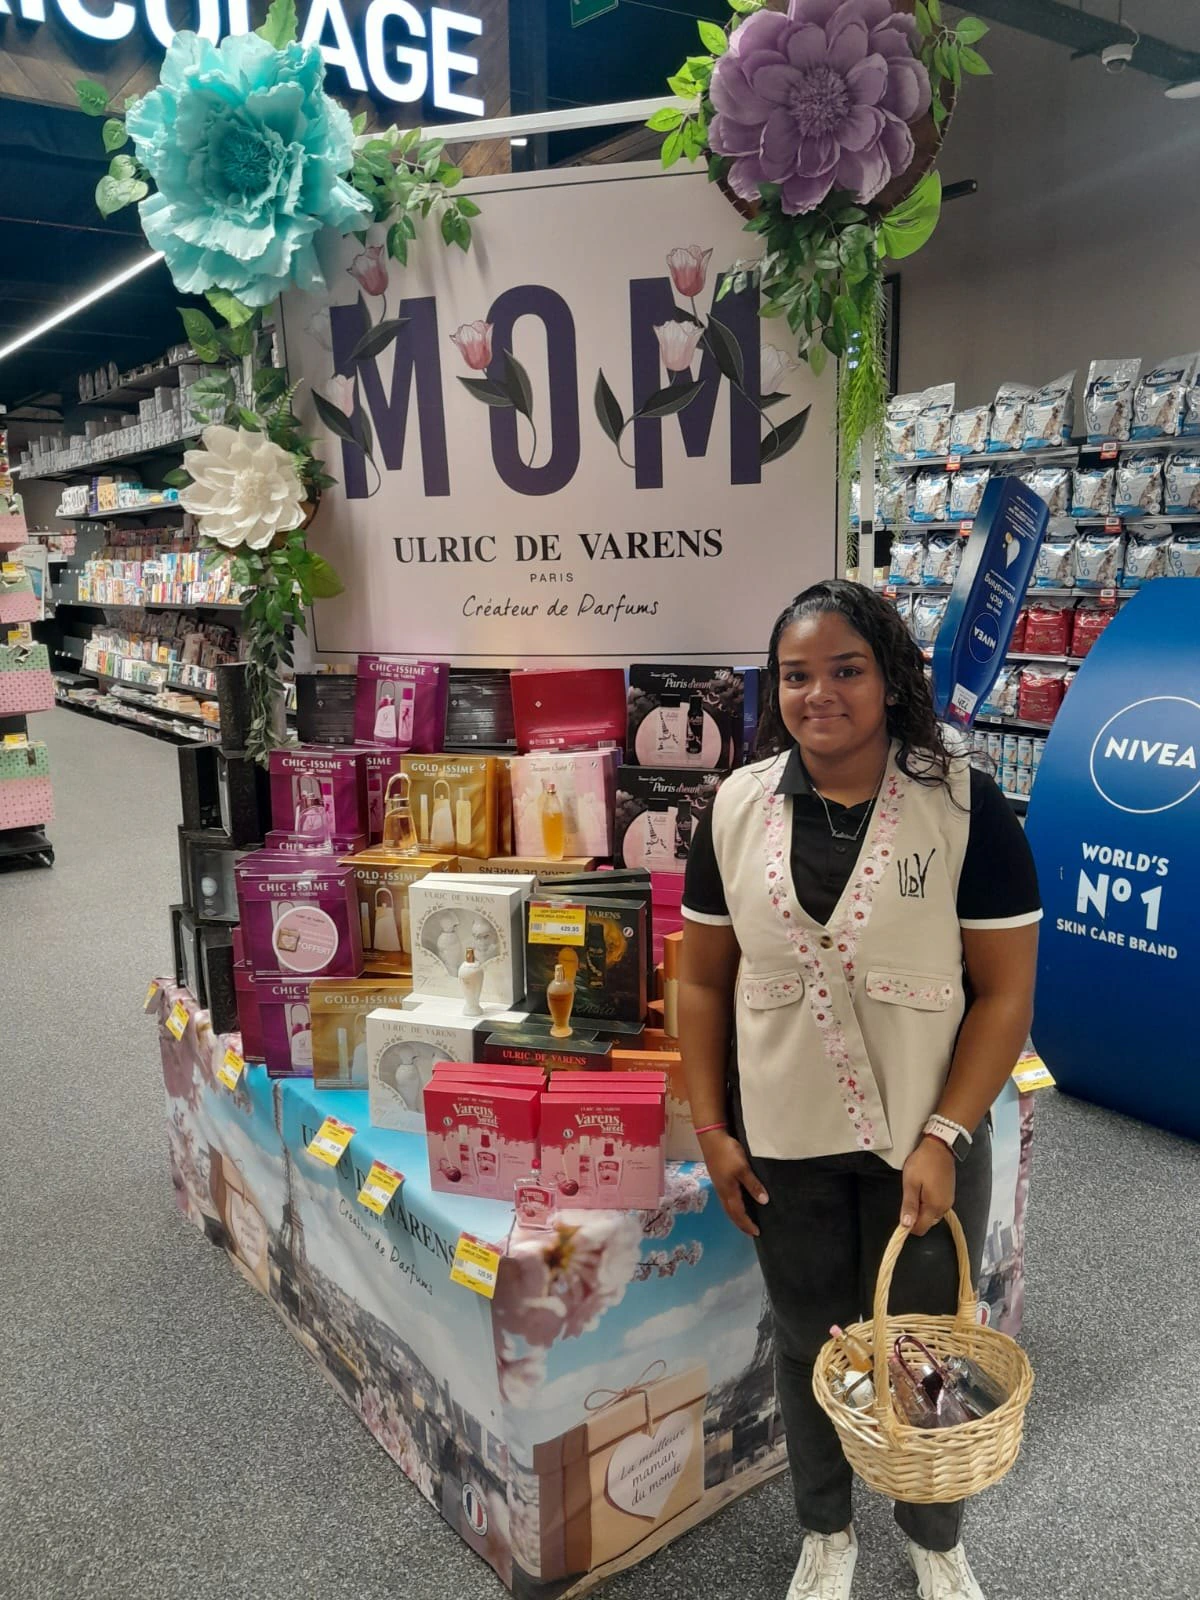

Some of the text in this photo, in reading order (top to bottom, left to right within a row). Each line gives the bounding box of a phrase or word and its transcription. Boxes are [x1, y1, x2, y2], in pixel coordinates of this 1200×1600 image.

[329, 271, 762, 499] MOM
[393, 528, 723, 564] ULRIC DE VARENS
[529, 571, 574, 583] PARIS
[462, 593, 659, 622] Créateur de Parfums
[973, 625, 997, 650] NIVEA
[369, 662, 426, 676] CHIC-ISSIME
[1104, 736, 1197, 769] NIVEA
[282, 758, 342, 770] CHIC-ISSIME
[411, 762, 475, 774] GOLD-ISSIME
[1082, 842, 1170, 877] WORLD'S
[258, 882, 329, 893] CHIC-ISSIME
[451, 893, 462, 902] DE
[588, 910, 621, 920] VARENS
[1056, 918, 1178, 960] SKIN CARE BRAND
[502, 1049, 530, 1060] ULRIC
[551, 1053, 587, 1065] VARENS
[452, 1103, 494, 1117] Varens
[574, 1113, 620, 1126] Varens
[620, 1426, 687, 1481] La meilleure
[632, 1450, 677, 1487] maman
[632, 1463, 681, 1507] du monde
